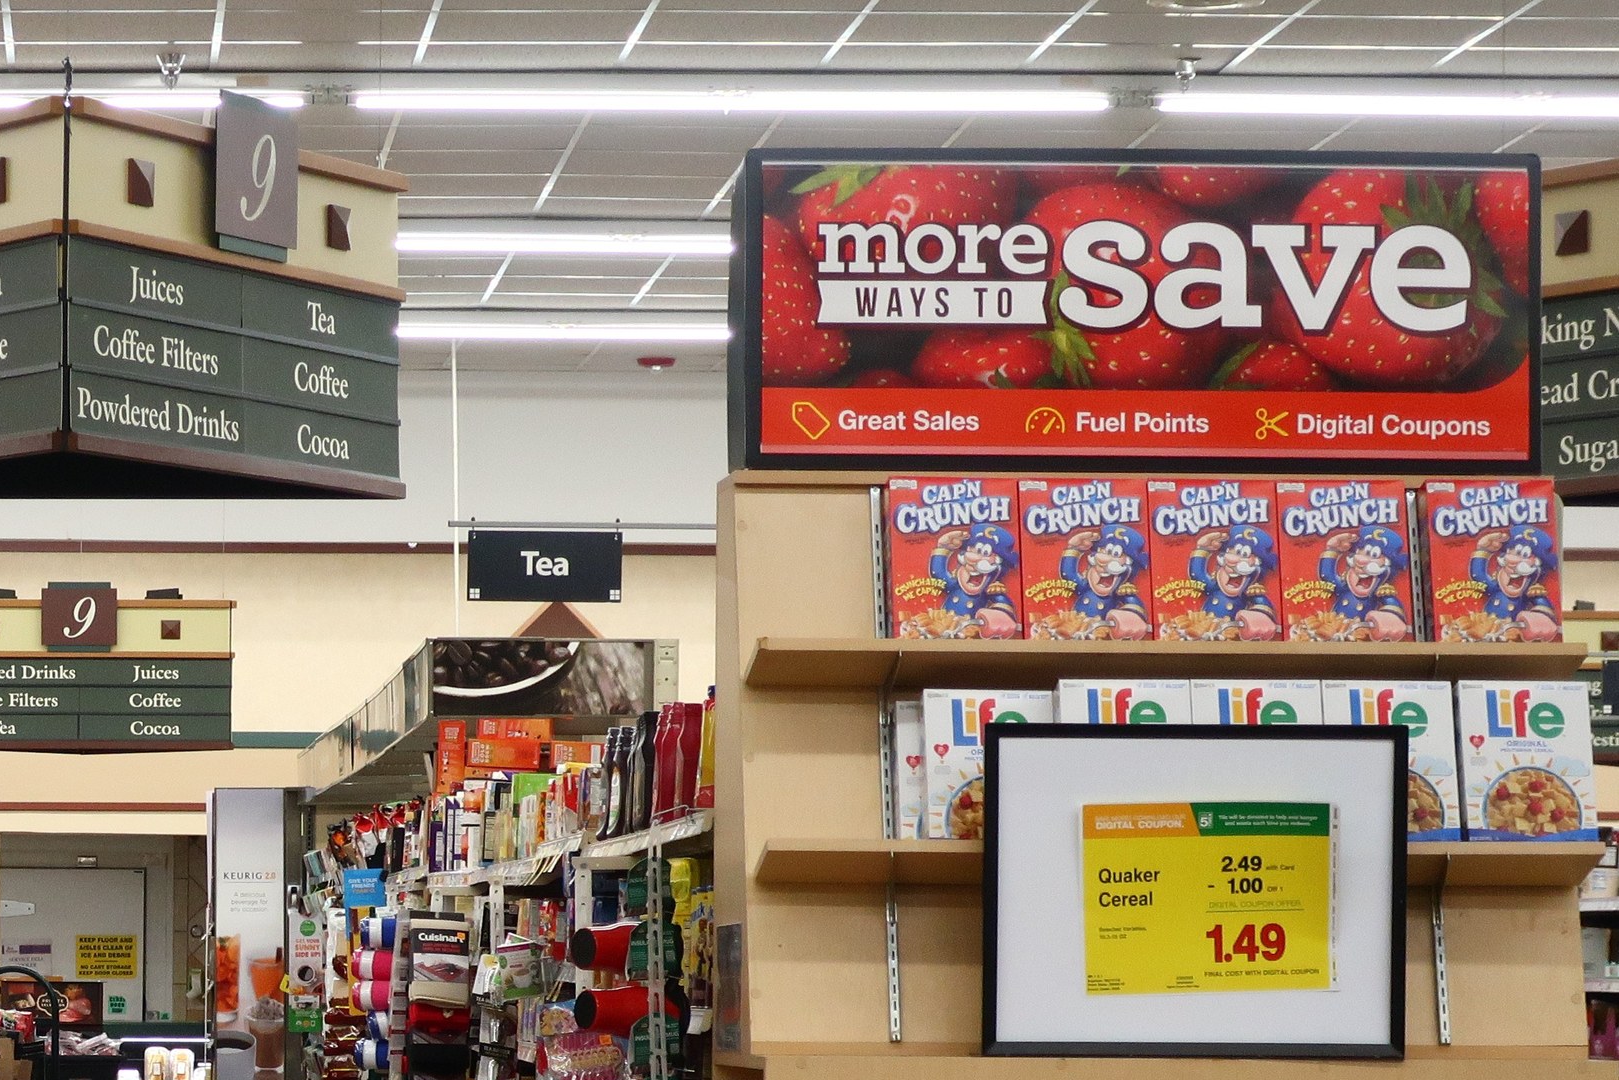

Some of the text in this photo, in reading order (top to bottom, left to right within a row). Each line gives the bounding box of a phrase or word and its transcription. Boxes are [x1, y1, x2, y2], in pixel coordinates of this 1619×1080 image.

[239, 134, 277, 222] 9
[817, 224, 1049, 274] more
[130, 266, 184, 306] Juices
[1058, 220, 1473, 331] save
[307, 302, 336, 335] Tea
[855, 288, 1013, 317] WAYS TO
[1541, 313, 1595, 350] king
[93, 326, 219, 375] Coffee Filters
[294, 362, 349, 399] Coffee
[77, 387, 238, 442] Powdered Drinks
[838, 409, 979, 433] Great Sales
[1076, 411, 1209, 435] Fuel Points
[1296, 413, 1490, 441] Digital Coupons
[297, 425, 349, 461] Cocoa
[1559, 435, 1619, 472] Suga
[897, 497, 1010, 533] CRUNCH
[1028, 498, 1140, 534] CRUNCH
[520, 551, 569, 576] Tea
[63, 597, 97, 638] 9
[21, 665, 76, 680] Drinks
[132, 665, 179, 681] Juices
[8, 692, 58, 708] Filters
[129, 693, 181, 708] Coffee
[1486, 689, 1565, 738] Life
[130, 721, 181, 736] Cocoa
[1096, 821, 1134, 830] DIGITAL
[1099, 868, 1160, 883] Quaker
[1221, 856, 1262, 872] 2.49
[1099, 892, 1153, 907] Cereal
[1228, 878, 1263, 894] 1.00
[1206, 923, 1286, 963] 1.49
